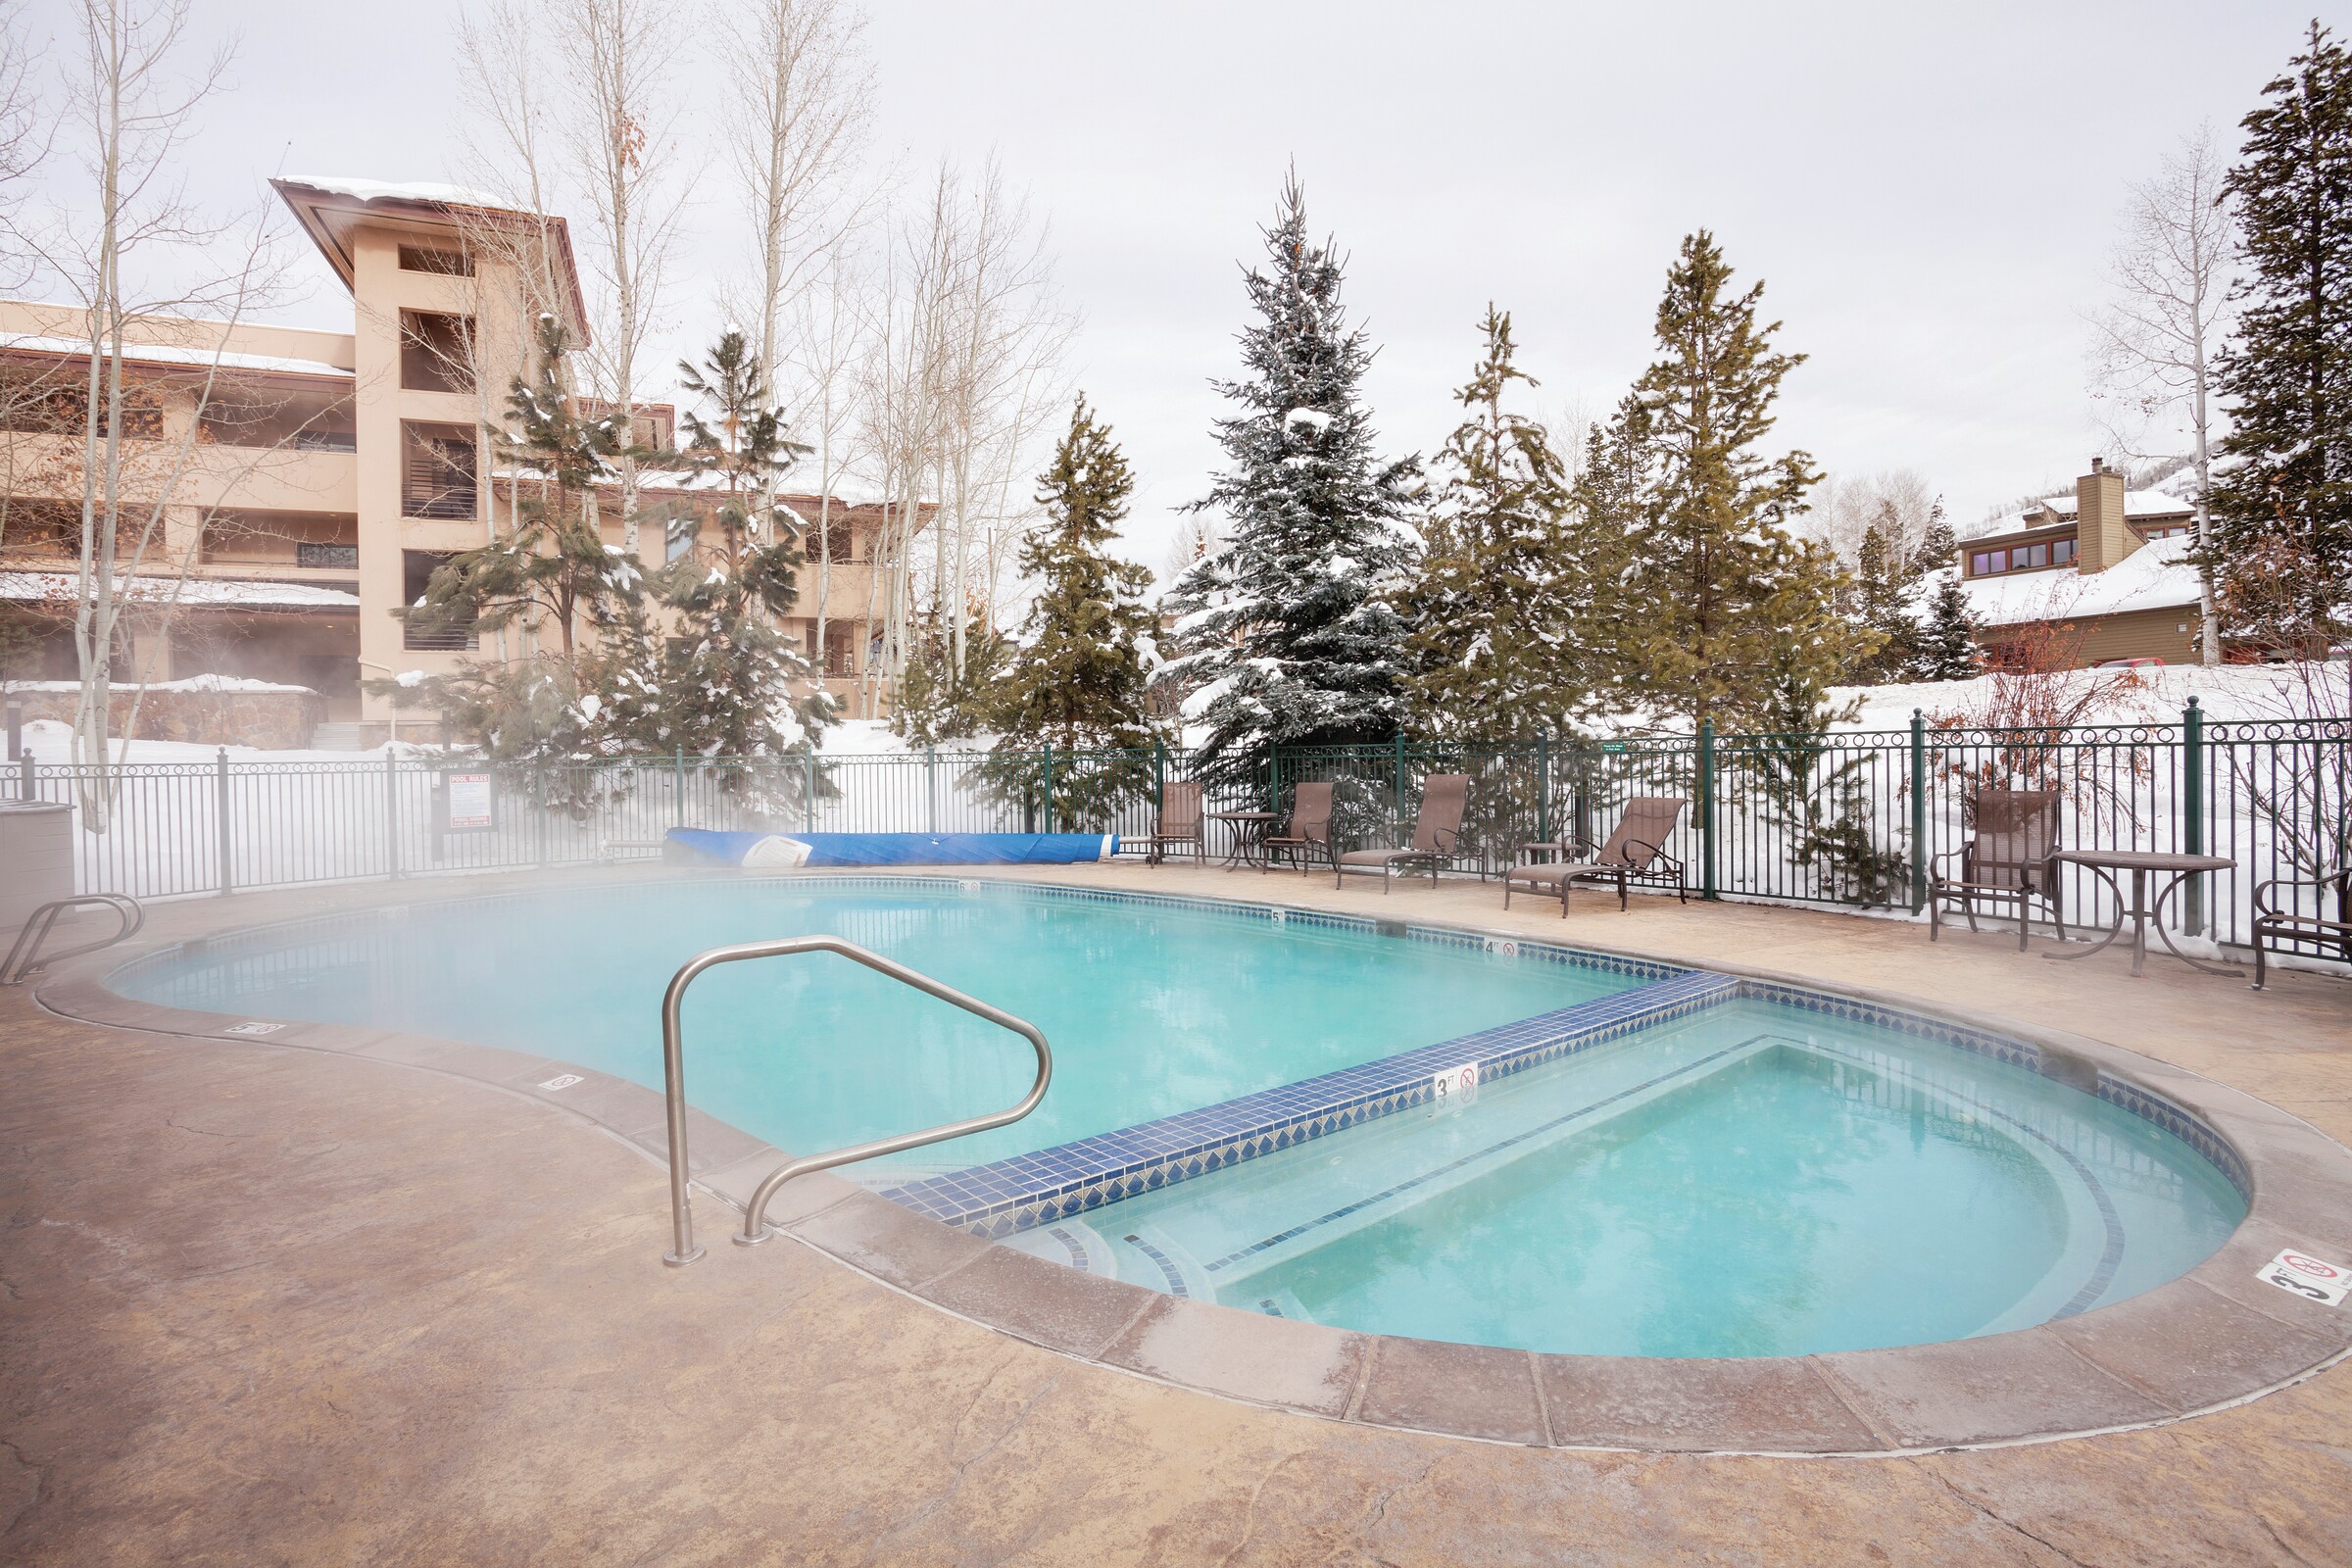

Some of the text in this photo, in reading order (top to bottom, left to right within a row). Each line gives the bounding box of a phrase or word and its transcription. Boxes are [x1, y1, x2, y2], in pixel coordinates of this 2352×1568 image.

[1273, 911, 1279, 921] 5
[1485, 941, 1494, 953] 4
[1437, 1074, 1454, 1097] 3 FT
[2270, 1275, 2330, 1299] 3
